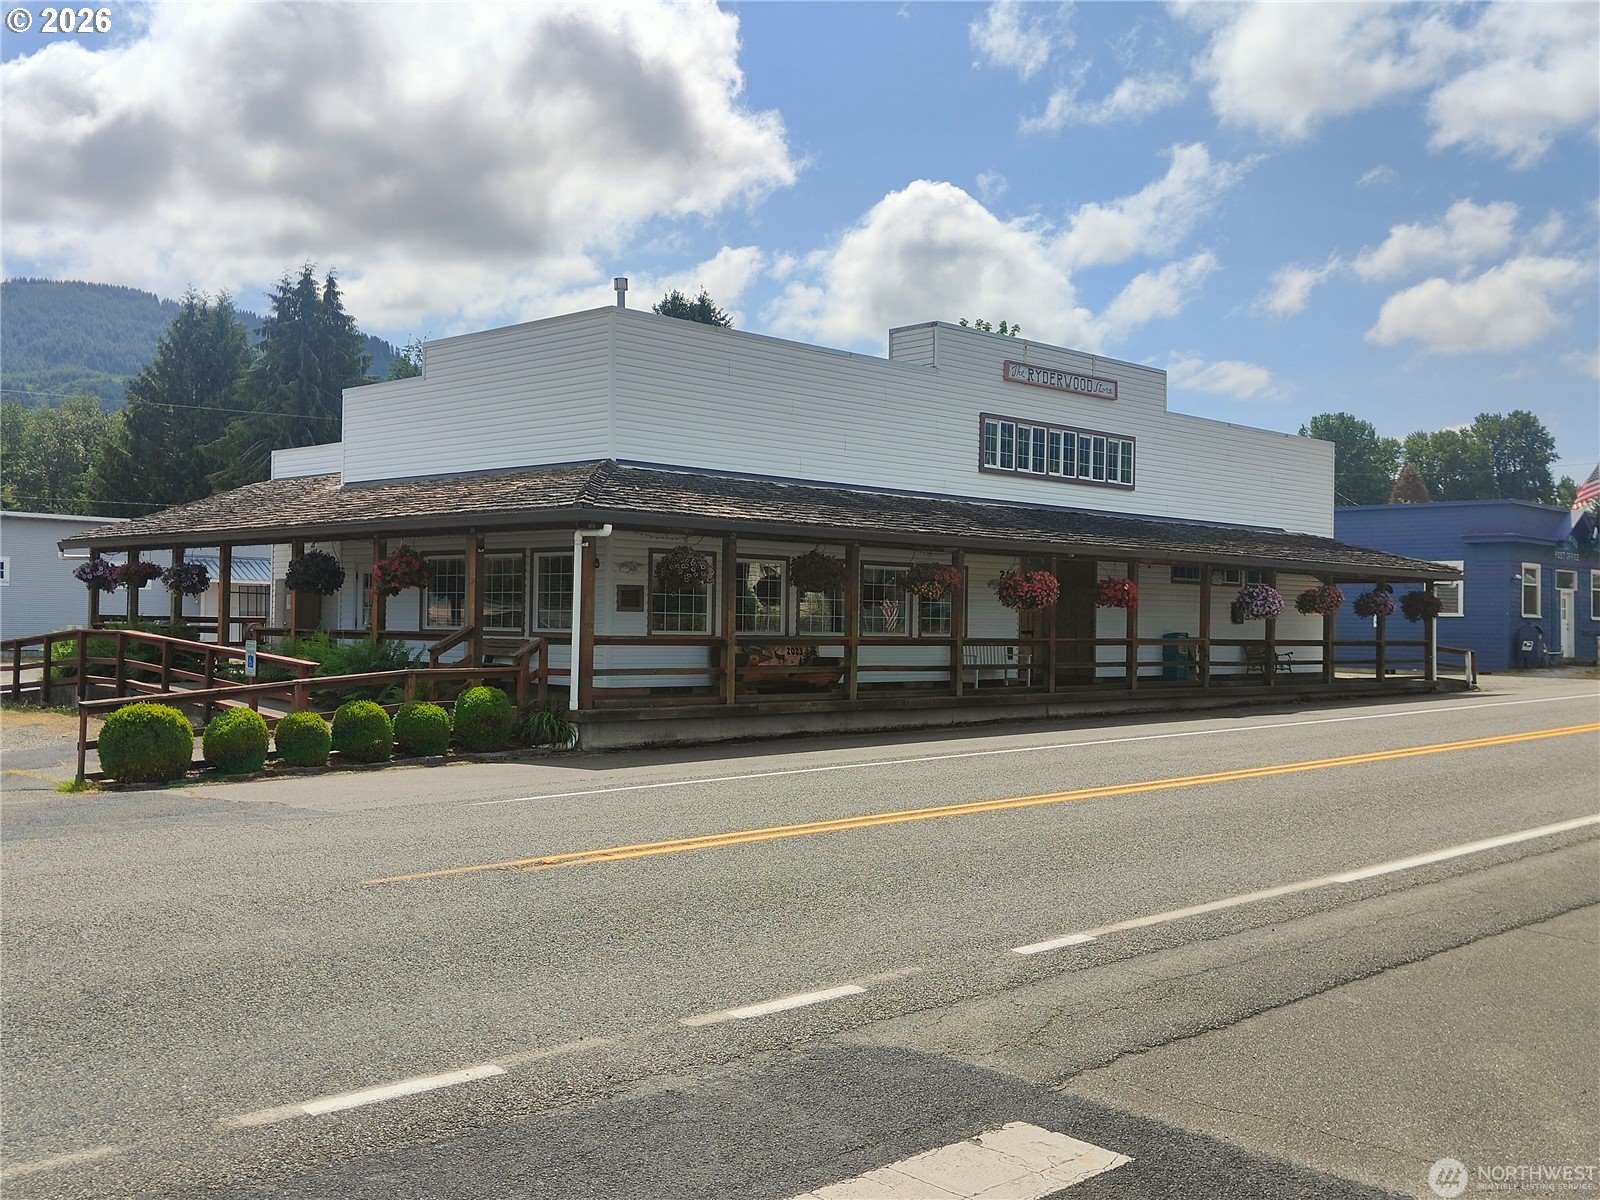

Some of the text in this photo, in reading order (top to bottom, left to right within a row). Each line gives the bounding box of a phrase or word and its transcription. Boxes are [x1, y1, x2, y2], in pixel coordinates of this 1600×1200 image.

[1011, 365, 1113, 395] The RYDERWOOD Store
[1554, 550, 1580, 562] POST OFFICE
[786, 646, 803, 656] 2023
